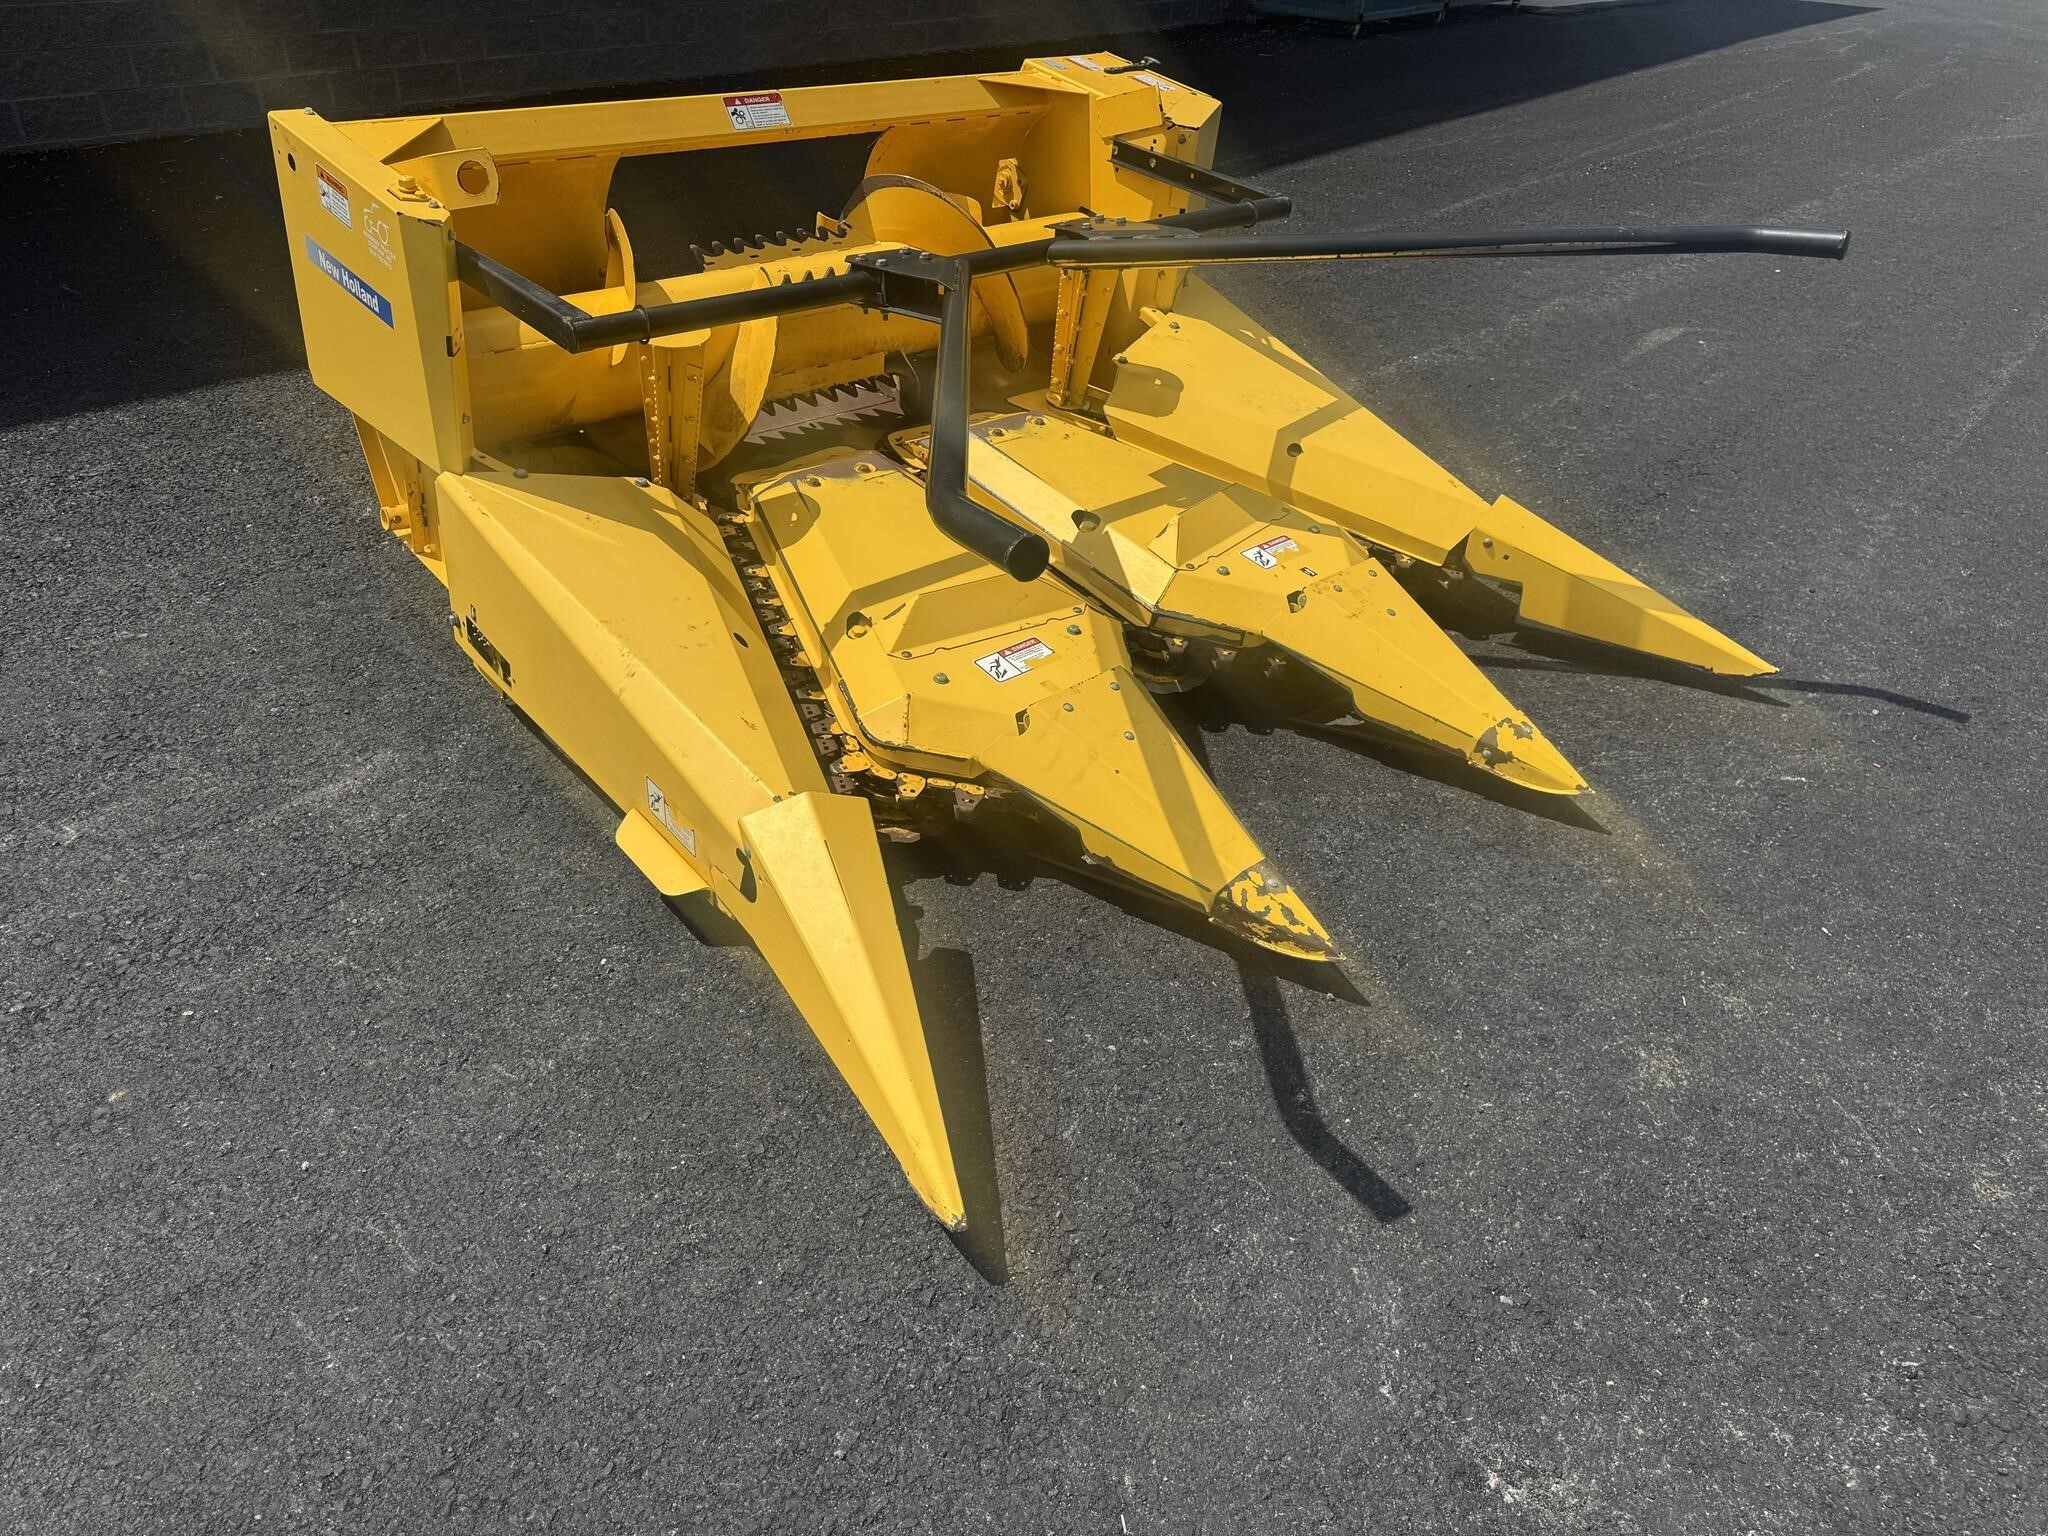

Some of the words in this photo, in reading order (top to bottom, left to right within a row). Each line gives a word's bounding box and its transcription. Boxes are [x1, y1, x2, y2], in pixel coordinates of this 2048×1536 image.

[744, 96, 771, 104] DANGER
[317, 248, 340, 281] New
[341, 267, 380, 314] Holland
[1011, 639, 1037, 652] DANGER
